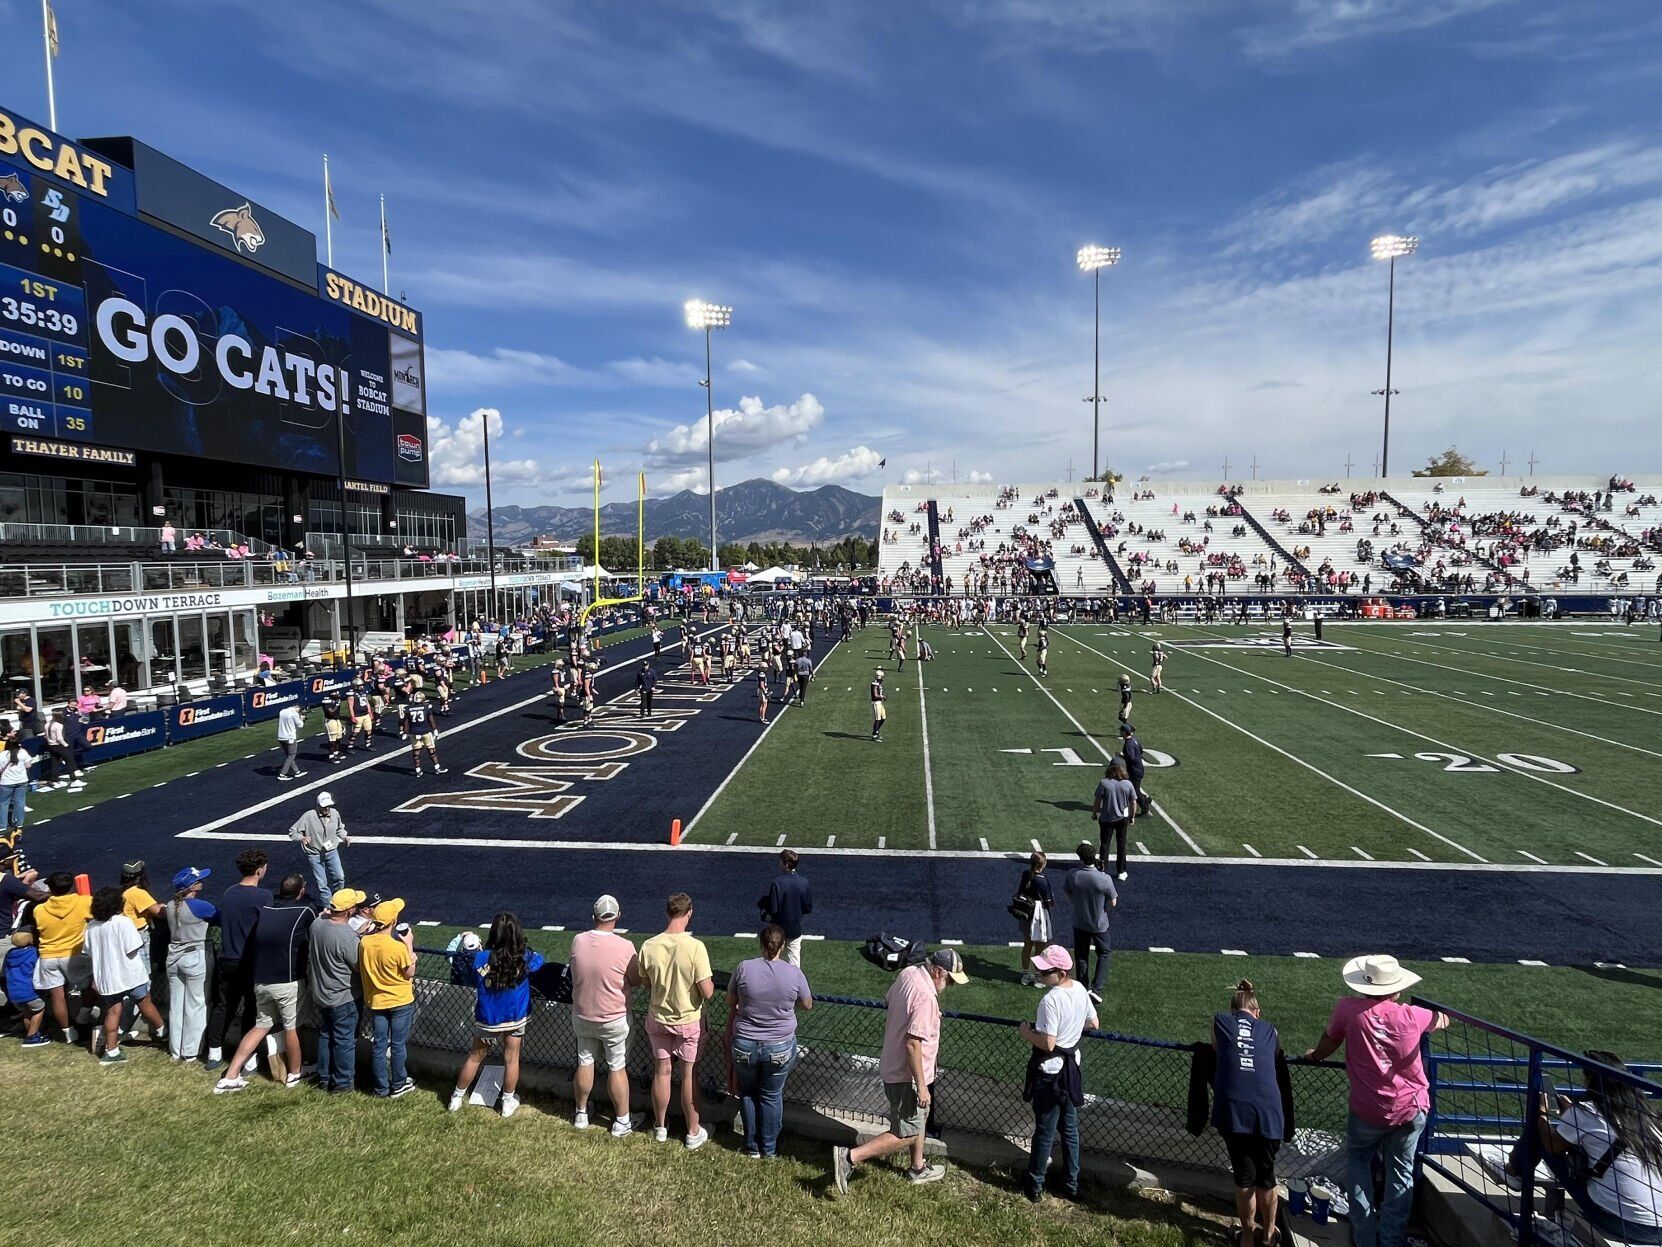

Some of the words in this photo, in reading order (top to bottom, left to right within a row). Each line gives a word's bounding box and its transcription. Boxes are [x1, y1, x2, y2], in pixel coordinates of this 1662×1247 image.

[3, 208, 17, 227] 0
[51, 226, 64, 244] 0
[20, 278, 58, 301] 1ST
[325, 272, 418, 335] STADIUM
[2, 297, 78, 336] 35:39
[0, 340, 46, 360] DOWN
[96, 297, 200, 375] GO
[215, 333, 351, 415] CATS!
[58, 354, 85, 369] 1ST
[3, 373, 24, 387] TO
[26, 378, 47, 392] GO
[360, 369, 384, 383] WELCOME
[369, 380, 377, 388] TO
[63, 385, 83, 400] 10
[358, 385, 388, 402] BOBCAT
[9, 403, 46, 419] BALL
[356, 398, 390, 416] STADIUM
[17, 416, 39, 430] ON
[66, 416, 86, 431] 35
[13, 438, 79, 458] THAYER
[82, 447, 134, 464] FAMILY
[400, 438, 420, 449] town
[400, 447, 421, 457] pump
[370, 484, 388, 493] FIELD
[267, 591, 303, 600] Bozeman
[305, 587, 329, 598] Health
[50, 597, 159, 616] TOUCHDOWN
[162, 594, 221, 609] TERRACE
[195, 707, 211, 717] First
[410, 711, 425, 722] 73
[105, 725, 125, 736] First
[1414, 752, 1577, 773] 20
